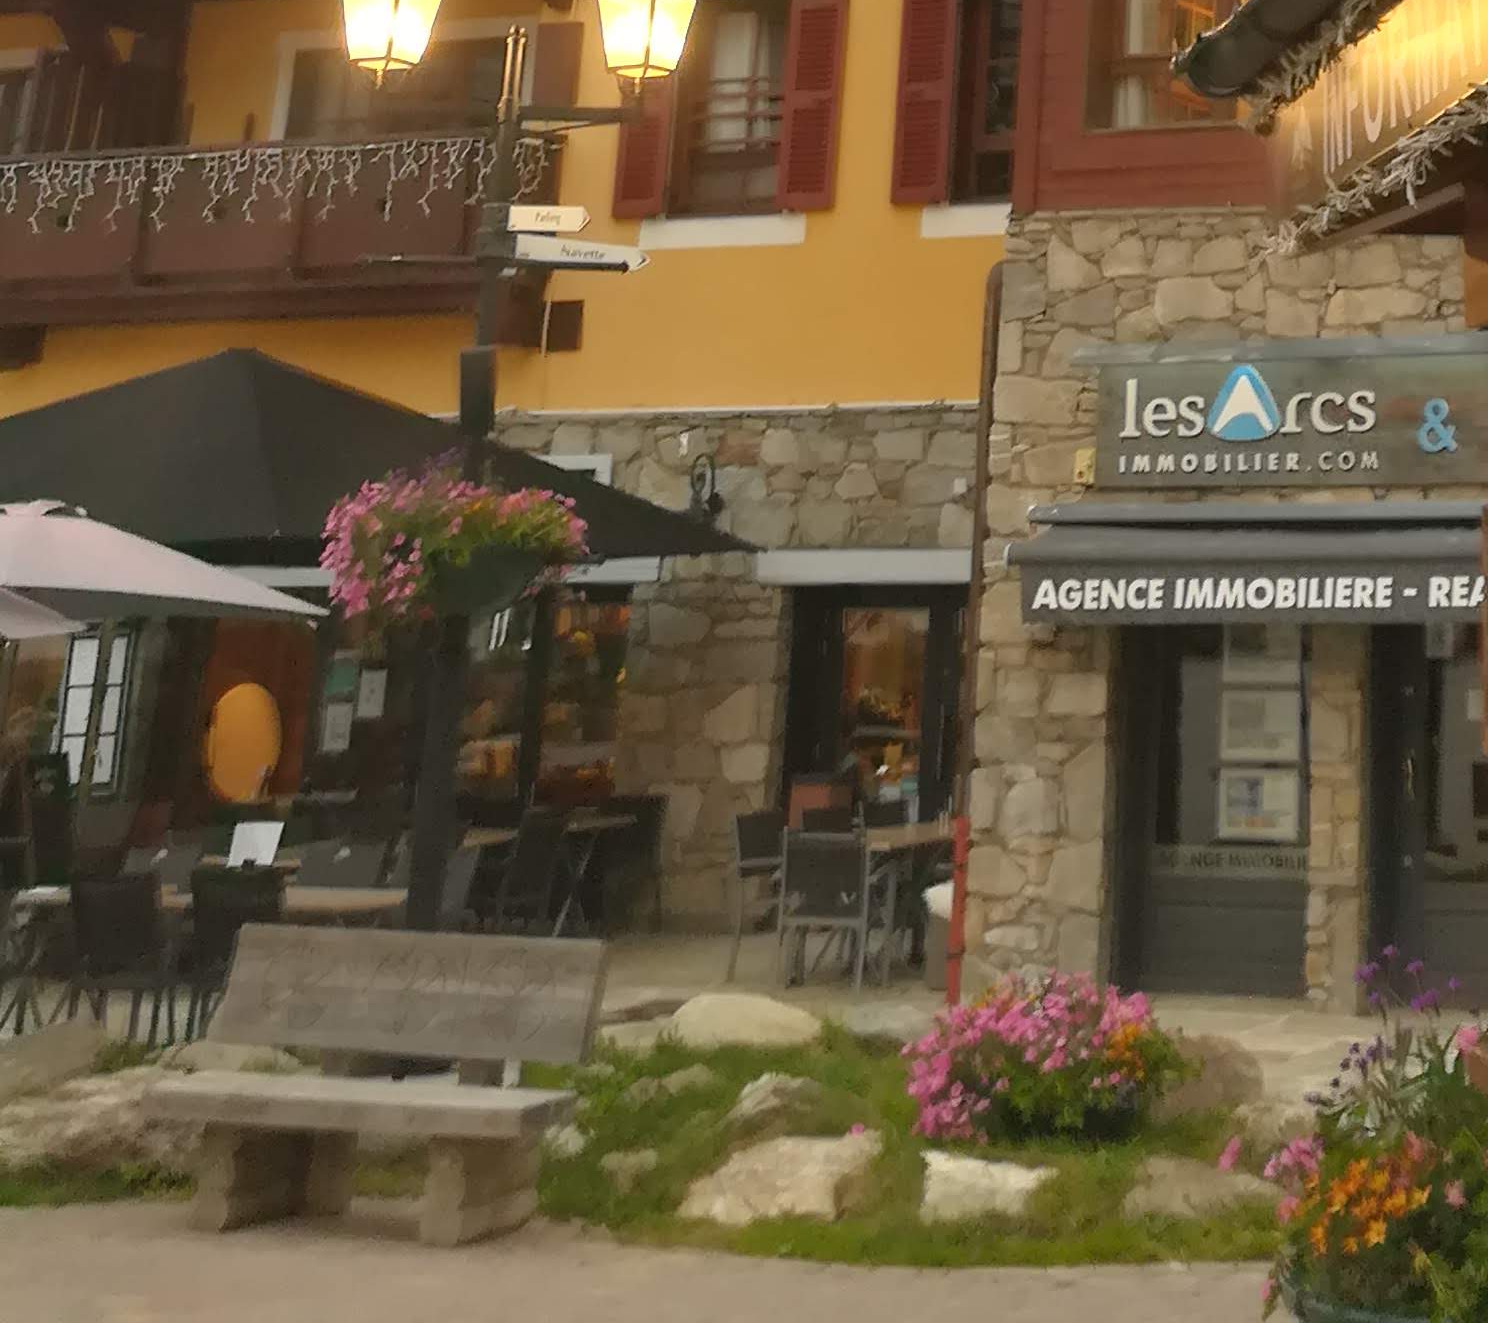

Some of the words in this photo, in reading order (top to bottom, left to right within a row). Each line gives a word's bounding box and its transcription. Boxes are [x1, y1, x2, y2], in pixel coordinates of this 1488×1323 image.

[1415, 397, 1458, 454] &
[1118, 450, 1380, 475] IMMOBILIER.COM
[1031, 577, 1165, 612] AGENCE
[1174, 575, 1394, 610] IMMOBILIERE
